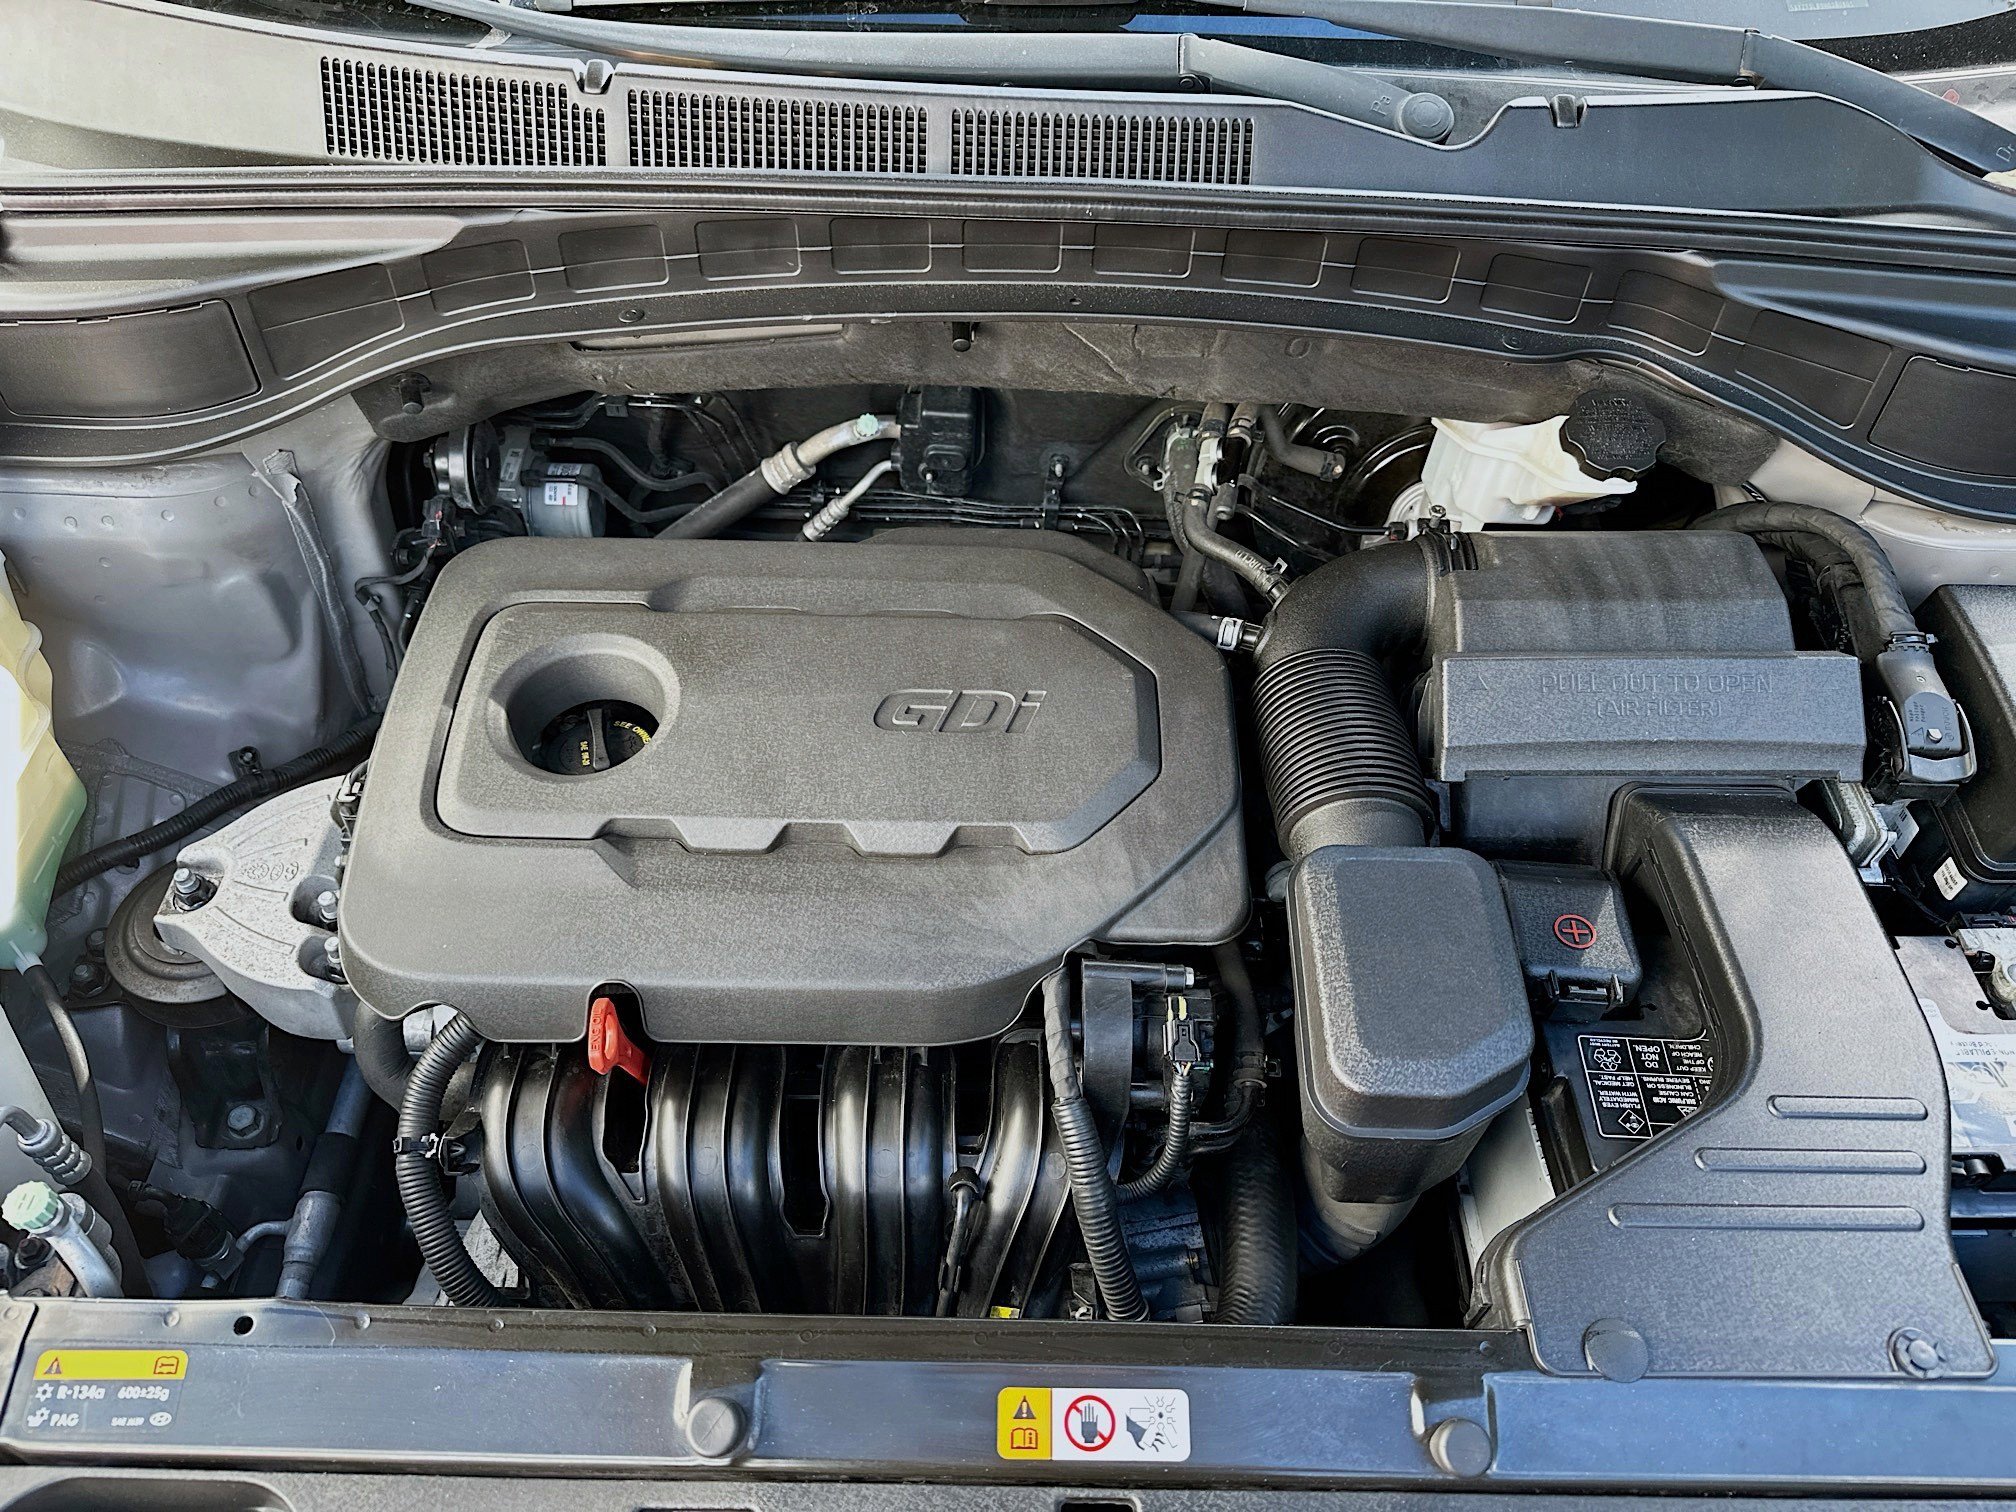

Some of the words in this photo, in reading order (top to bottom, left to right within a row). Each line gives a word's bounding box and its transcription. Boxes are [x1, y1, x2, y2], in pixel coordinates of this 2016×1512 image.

[1542, 672, 1603, 693] PULL
[1612, 672, 1661, 693] OUT
[1667, 673, 1700, 693] TO
[1707, 673, 1774, 694] OPEN
[873, 688, 1047, 734] GDi
[613, 720, 633, 729] SEE
[592, 1028, 601, 1050] ENG
[56, 1384, 106, 1400] R-134a
[50, 1413, 79, 1427] PAG
